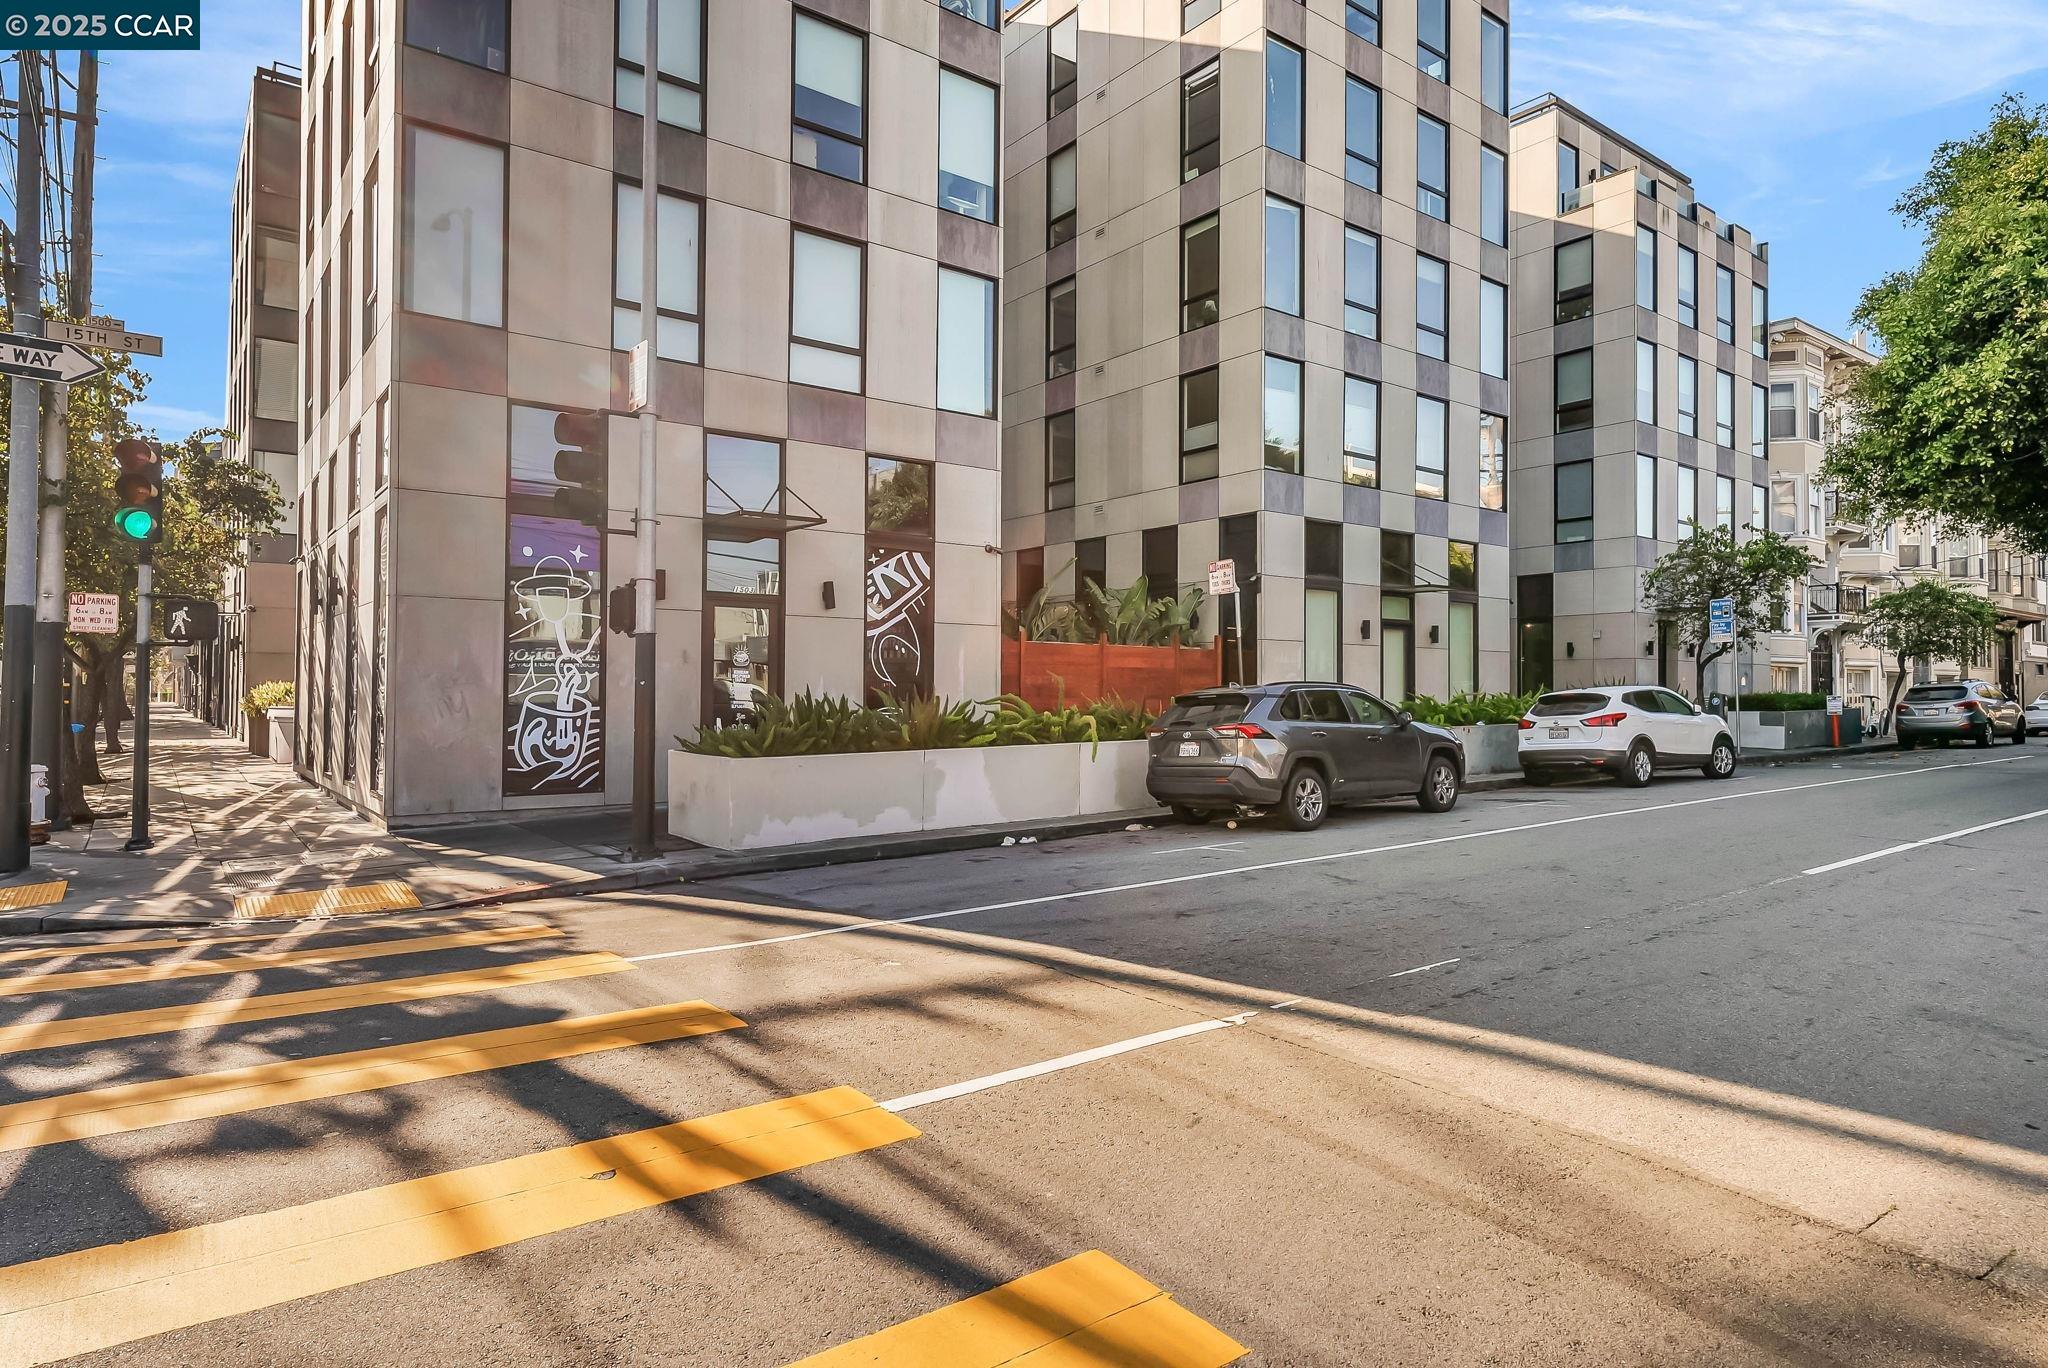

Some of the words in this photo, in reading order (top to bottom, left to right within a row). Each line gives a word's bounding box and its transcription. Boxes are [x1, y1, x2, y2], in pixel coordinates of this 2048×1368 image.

[88, 316, 111, 327] 1500
[66, 327, 107, 344] 15TH
[124, 336, 143, 349] ST
[13, 348, 58, 367] WAY
[71, 594, 84, 605] NO
[87, 597, 116, 606] PARKING
